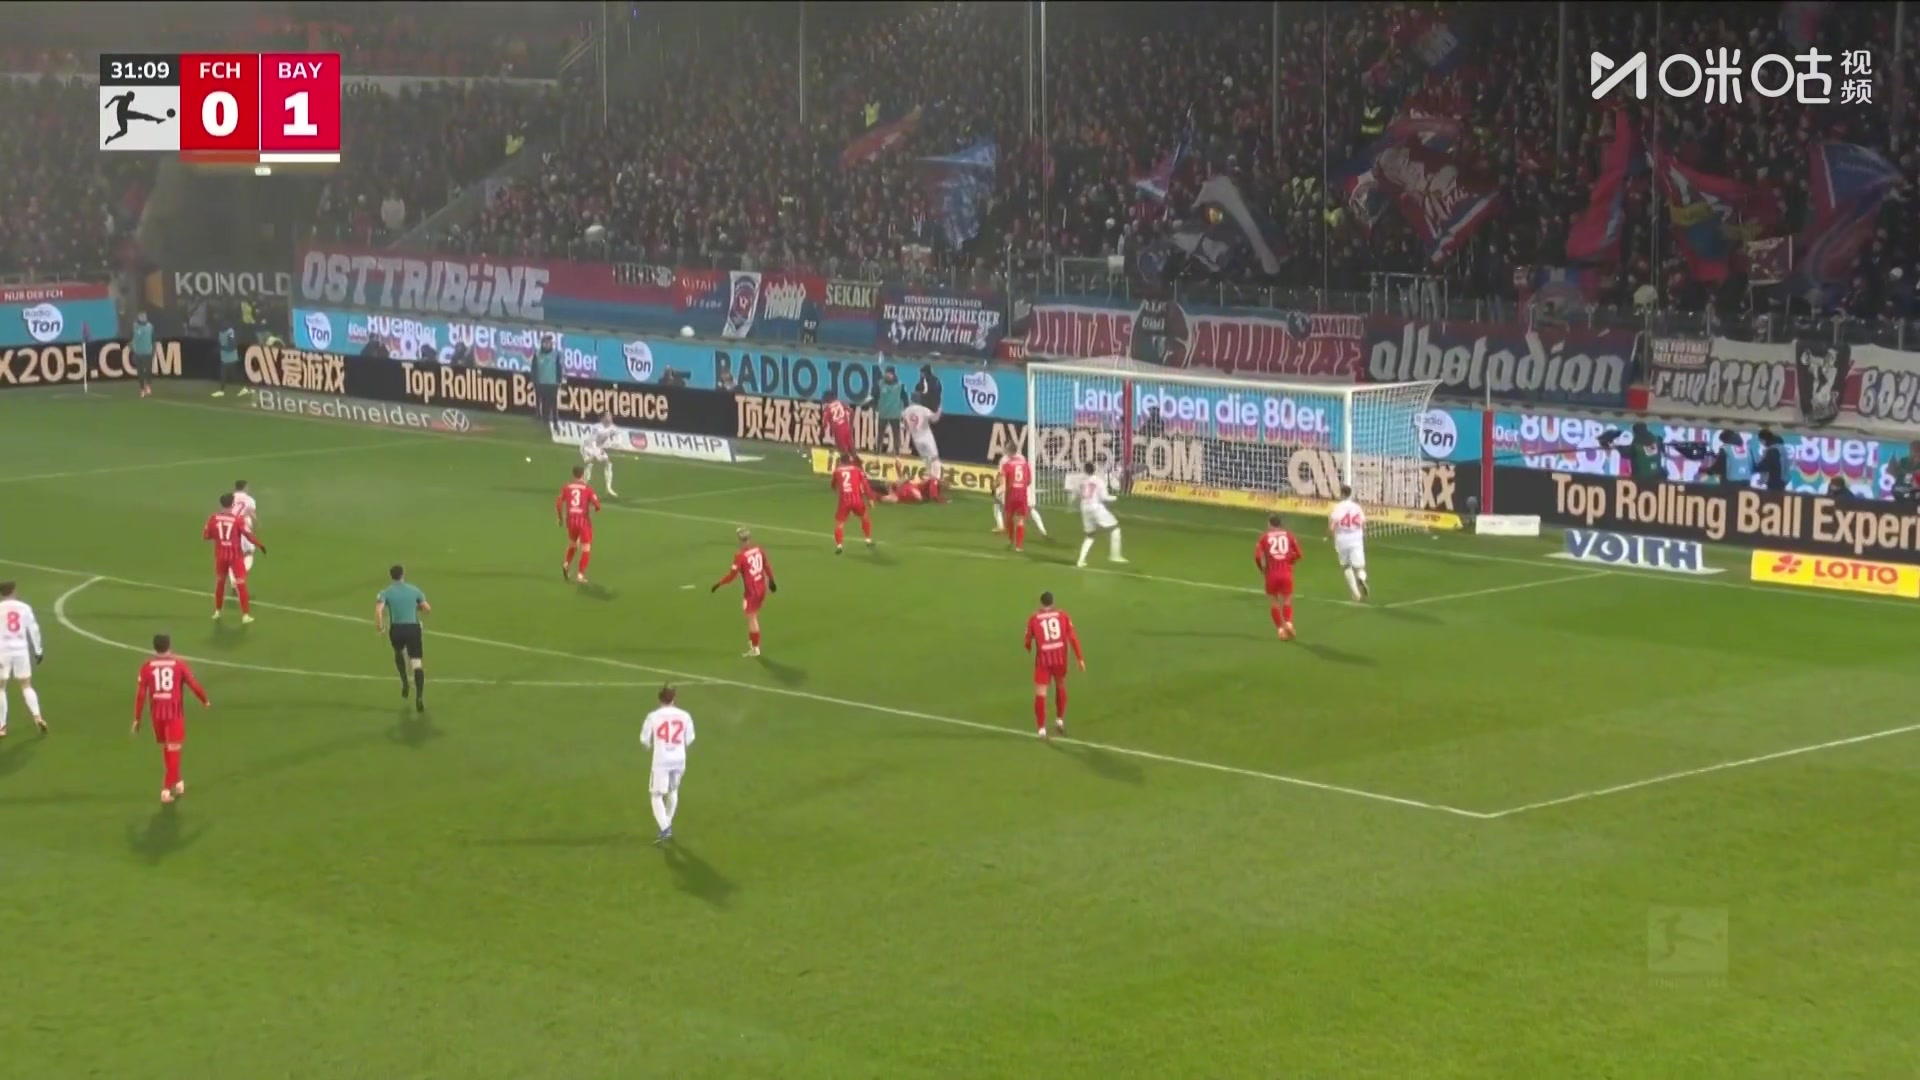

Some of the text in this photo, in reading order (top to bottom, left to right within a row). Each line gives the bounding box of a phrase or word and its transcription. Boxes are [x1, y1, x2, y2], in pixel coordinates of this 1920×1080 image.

[32, 320, 60, 333] Ton
[312, 327, 330, 341] Ton
[565, 348, 598, 371] 80er
[1009, 346, 1025, 359] NU
[630, 357, 651, 373] Ton
[715, 351, 818, 397] RADIO
[401, 362, 436, 403] Top
[441, 366, 507, 411] Rolling
[557, 378, 669, 421] Experience
[970, 389, 996, 406] Ton
[258, 390, 431, 427] Bierschneider
[1135, 384, 1210, 421] leben
[1216, 393, 1260, 426] die
[678, 436, 723, 454] MHP
[1423, 429, 1454, 447] Ton
[841, 471, 851, 488] 2
[571, 489, 581, 506] 3
[1552, 473, 1606, 525] Top
[1616, 480, 1727, 541] Rolling
[1737, 491, 1802, 539] Ball
[215, 520, 233, 540] 17
[1268, 535, 1289, 555] 20
[1566, 529, 1703, 571] VOITH
[748, 552, 763, 576] 30
[1815, 559, 1898, 585] LOTTO
[6, 611, 21, 634] 8
[1040, 617, 1062, 641] 19
[152, 667, 174, 692] 18
[656, 719, 684, 745] 42
